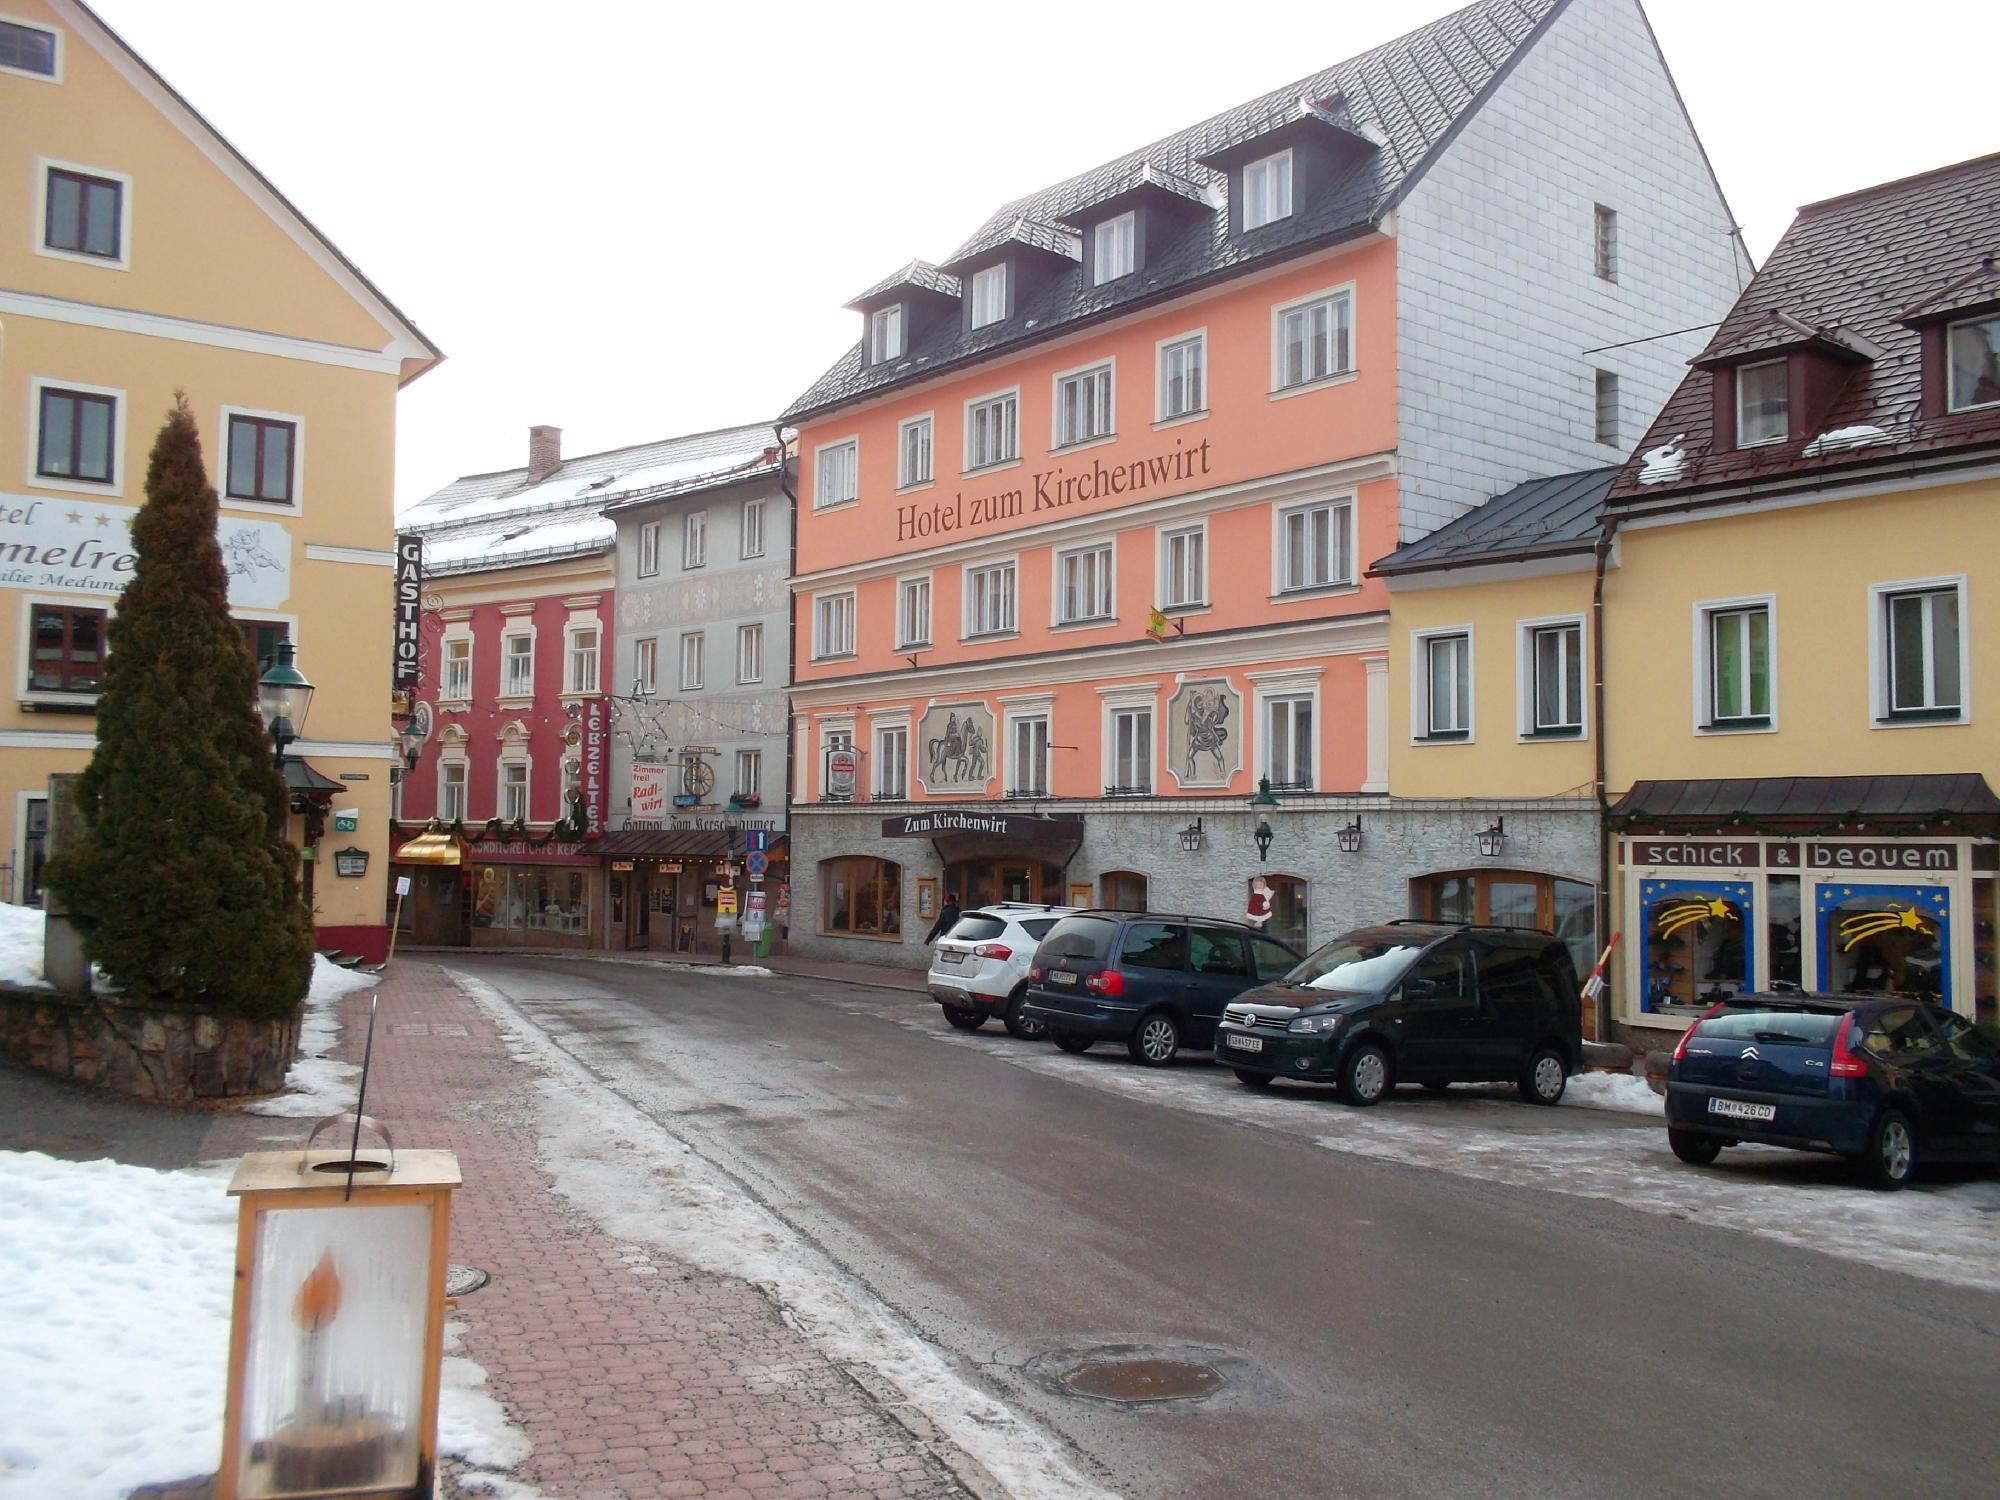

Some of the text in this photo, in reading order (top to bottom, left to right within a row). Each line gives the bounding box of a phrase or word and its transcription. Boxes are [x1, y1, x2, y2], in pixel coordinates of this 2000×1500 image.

[896, 437, 1210, 541] Hotel zum Kirchenwirt
[398, 544, 418, 678] GASTHOF
[586, 702, 600, 832] LEBZELTER
[633, 765, 664, 774] Zimmer
[641, 798, 663, 811] wirt
[904, 813, 1007, 833] Zum Kirchenwirt
[1648, 844, 1950, 867] schick & bequem
